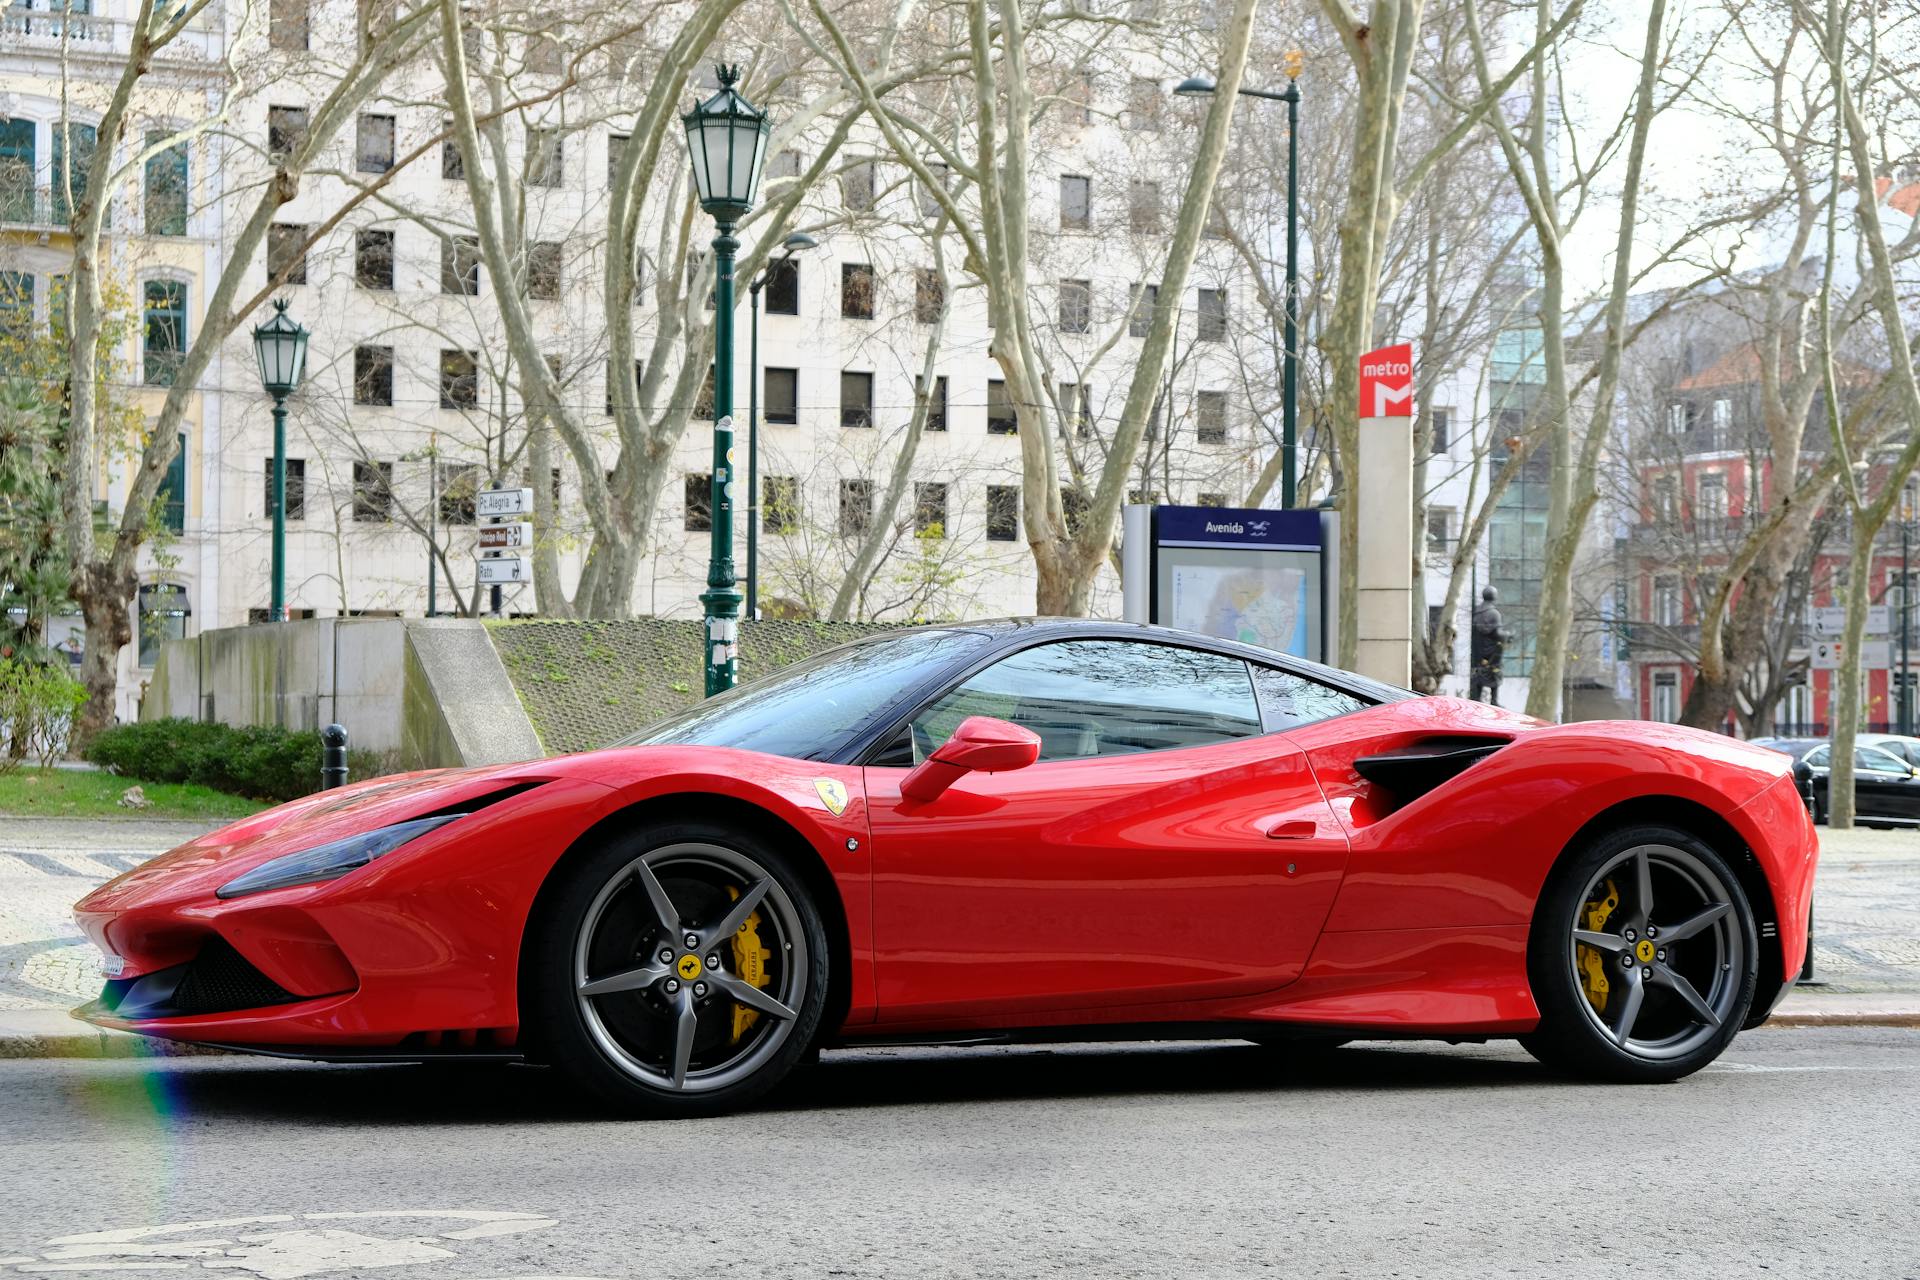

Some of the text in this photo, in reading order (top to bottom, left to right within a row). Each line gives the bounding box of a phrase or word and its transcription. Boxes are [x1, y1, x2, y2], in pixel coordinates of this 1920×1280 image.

[1363, 361, 1410, 377] metro
[1205, 521, 1244, 534] Avenida
[480, 565, 493, 579] Rato
